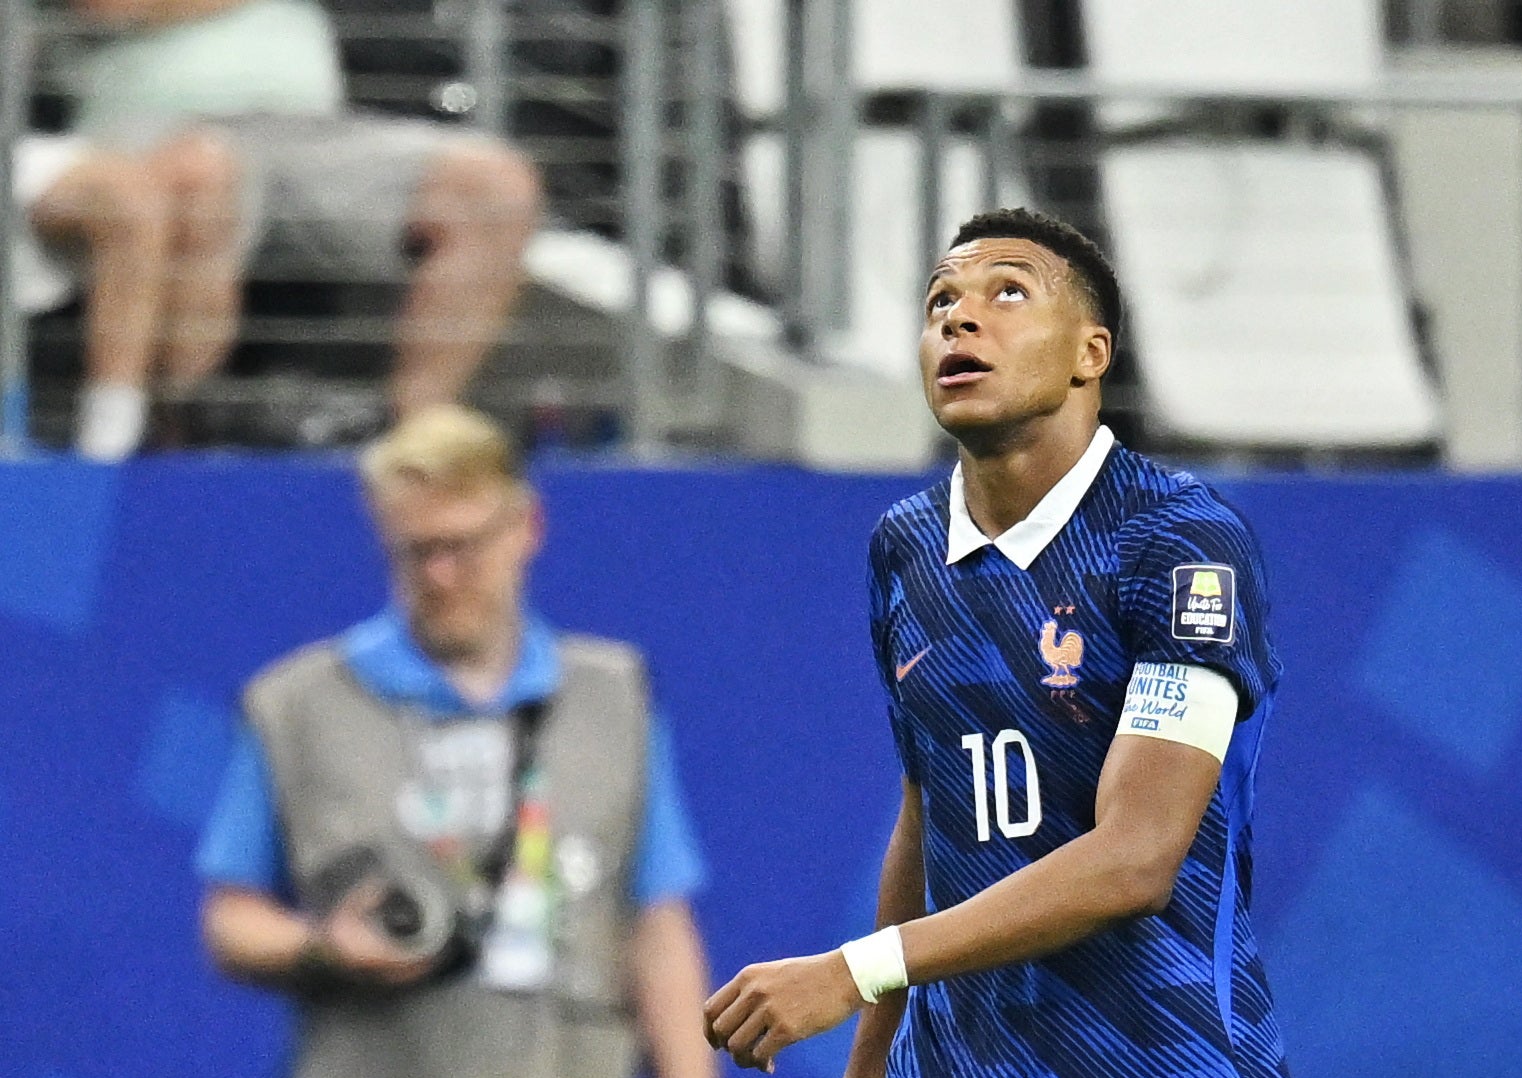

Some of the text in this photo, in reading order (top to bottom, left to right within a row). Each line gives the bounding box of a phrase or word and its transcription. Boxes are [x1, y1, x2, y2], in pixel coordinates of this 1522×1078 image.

[1135, 661, 1189, 682] FOOTBALL
[1129, 676, 1188, 702] UNITES
[1140, 698, 1188, 721] World
[961, 728, 1042, 842] 10
